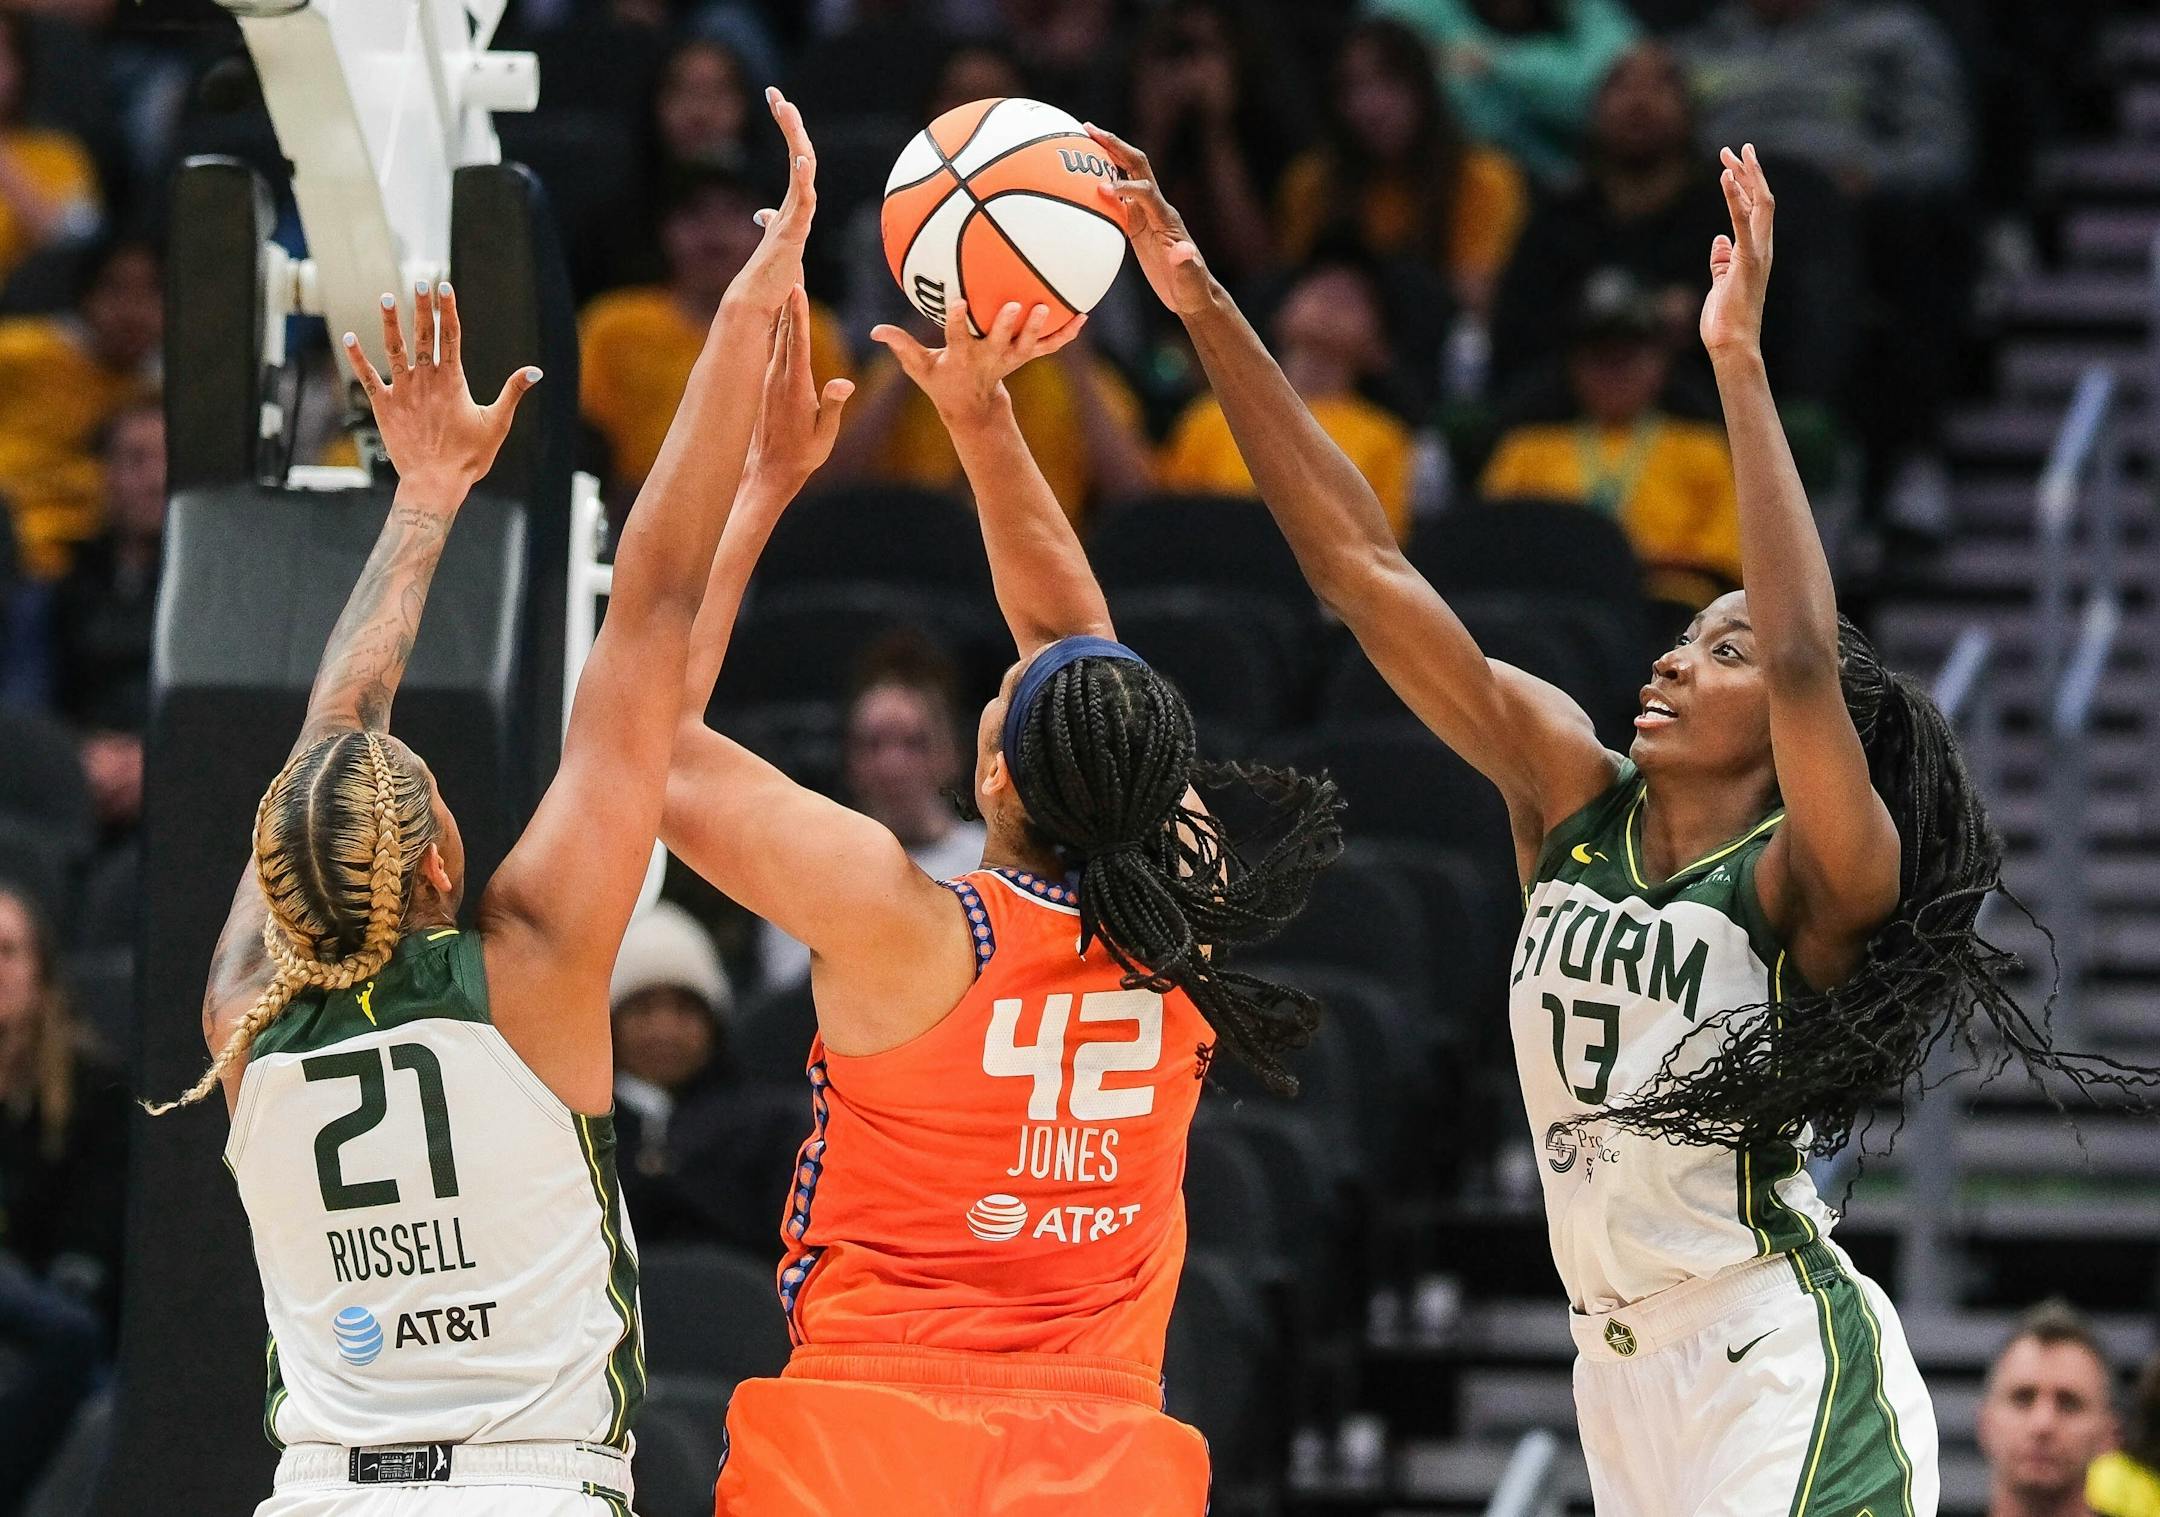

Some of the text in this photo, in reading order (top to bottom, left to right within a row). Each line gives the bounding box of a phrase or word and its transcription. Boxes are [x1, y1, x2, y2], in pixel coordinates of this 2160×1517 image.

[1512, 899, 1710, 1023] STORM
[982, 988, 1164, 1121] 42
[1541, 992, 1621, 1105] 13
[301, 1042, 459, 1212] 21
[1006, 1124, 1119, 1182] JONES
[326, 1217, 476, 1282] RUSSELL
[1032, 1203, 1141, 1244] AT&T
[395, 1301, 497, 1349] AT&T
